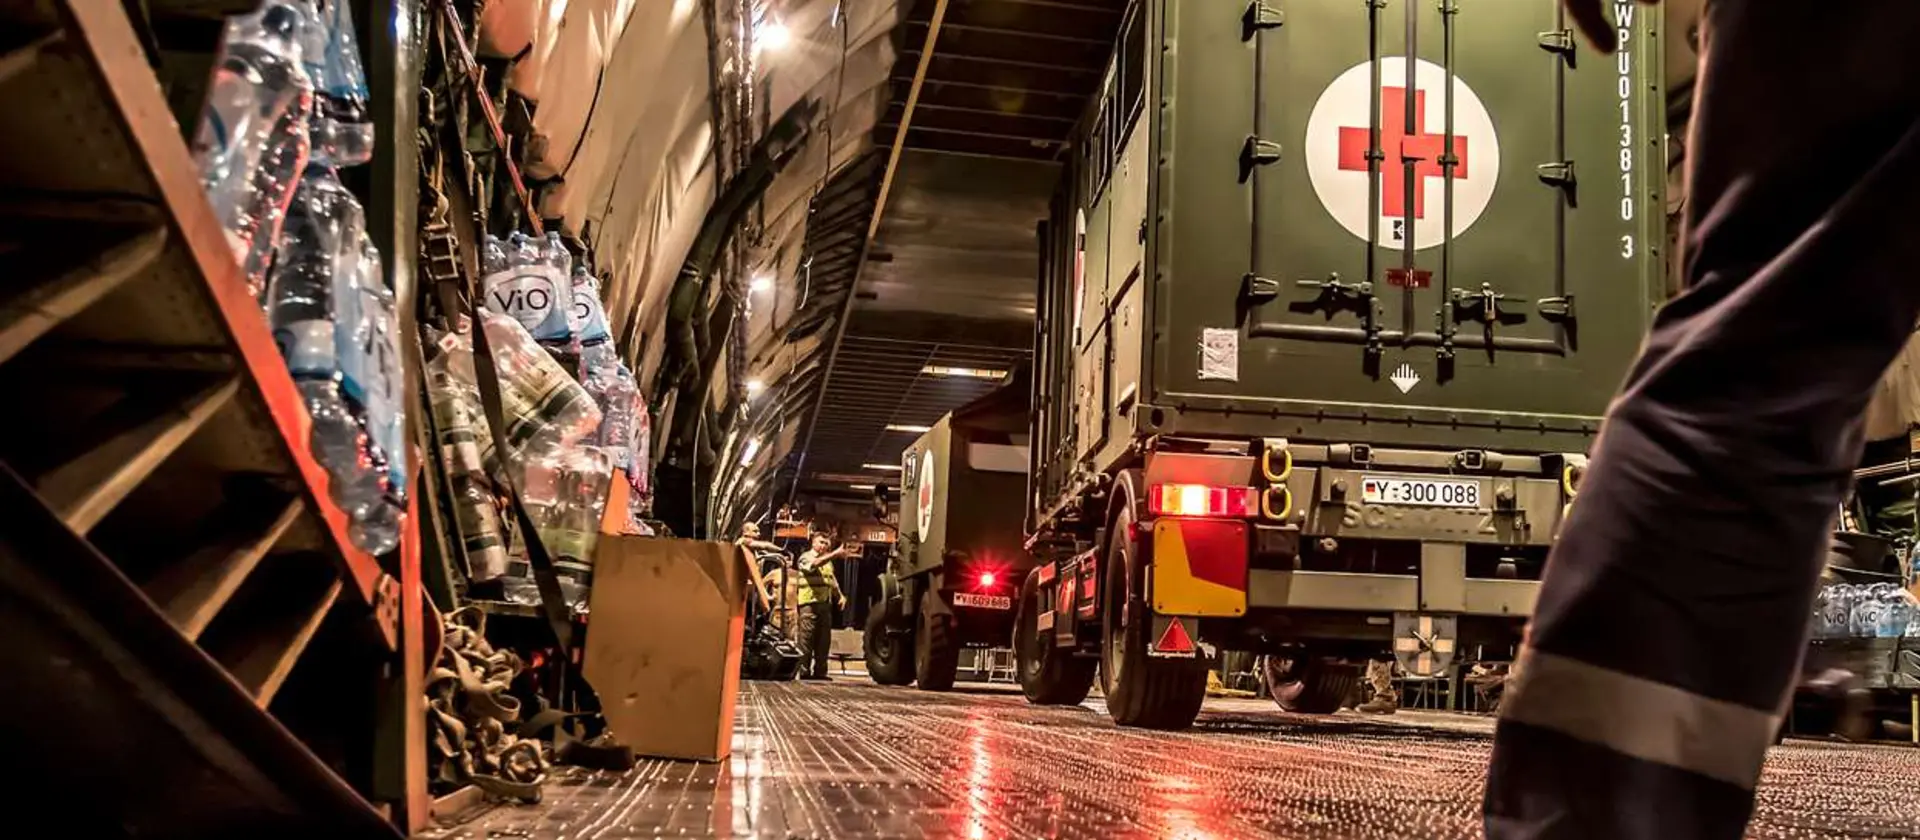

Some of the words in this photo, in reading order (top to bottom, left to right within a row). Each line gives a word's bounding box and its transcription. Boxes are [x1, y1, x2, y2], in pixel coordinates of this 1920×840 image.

[1614, 0, 1633, 220] WPU013810
[1621, 235, 1633, 259] 3
[493, 289, 548, 313] ViO
[1442, 484, 1477, 504] 088
